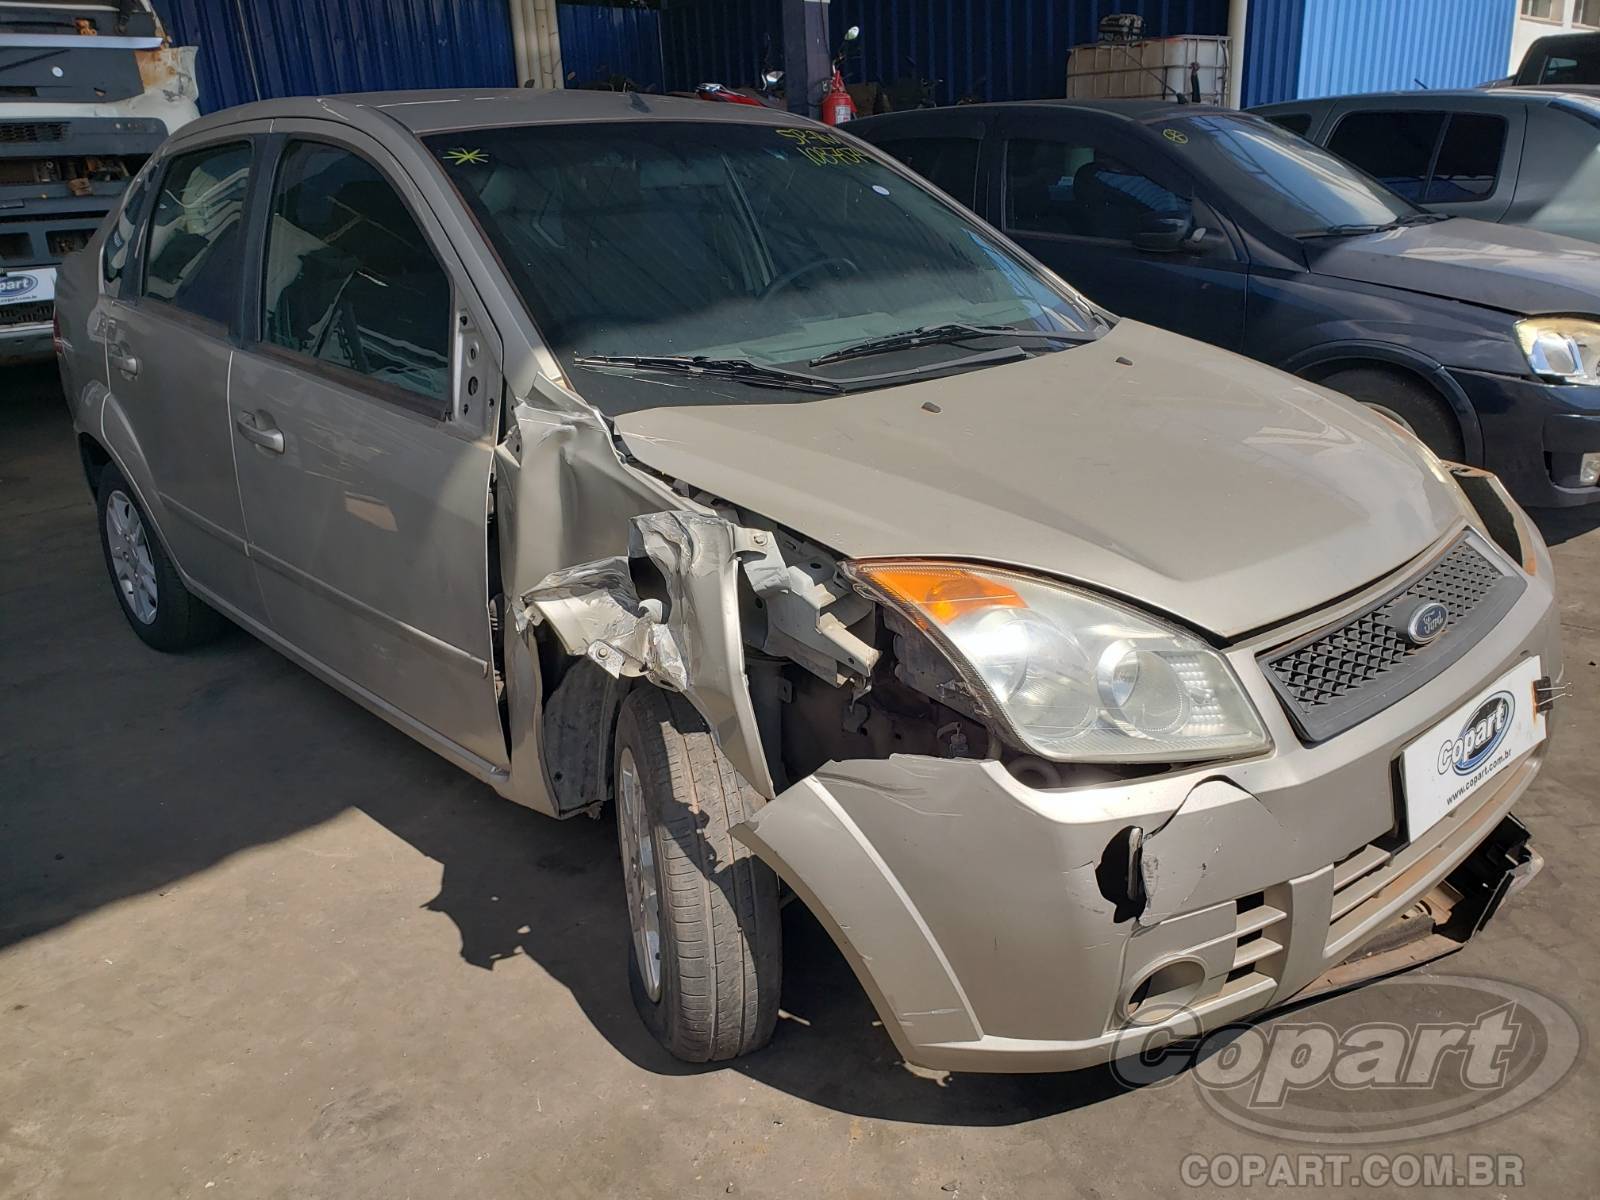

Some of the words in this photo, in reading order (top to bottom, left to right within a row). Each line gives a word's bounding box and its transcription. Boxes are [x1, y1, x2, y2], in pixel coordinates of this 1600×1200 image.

[0, 278, 29, 293] part
[1424, 611, 1444, 634] Ford
[1438, 699, 1507, 775] Copart
[1446, 749, 1512, 806] www.copart.com.br
